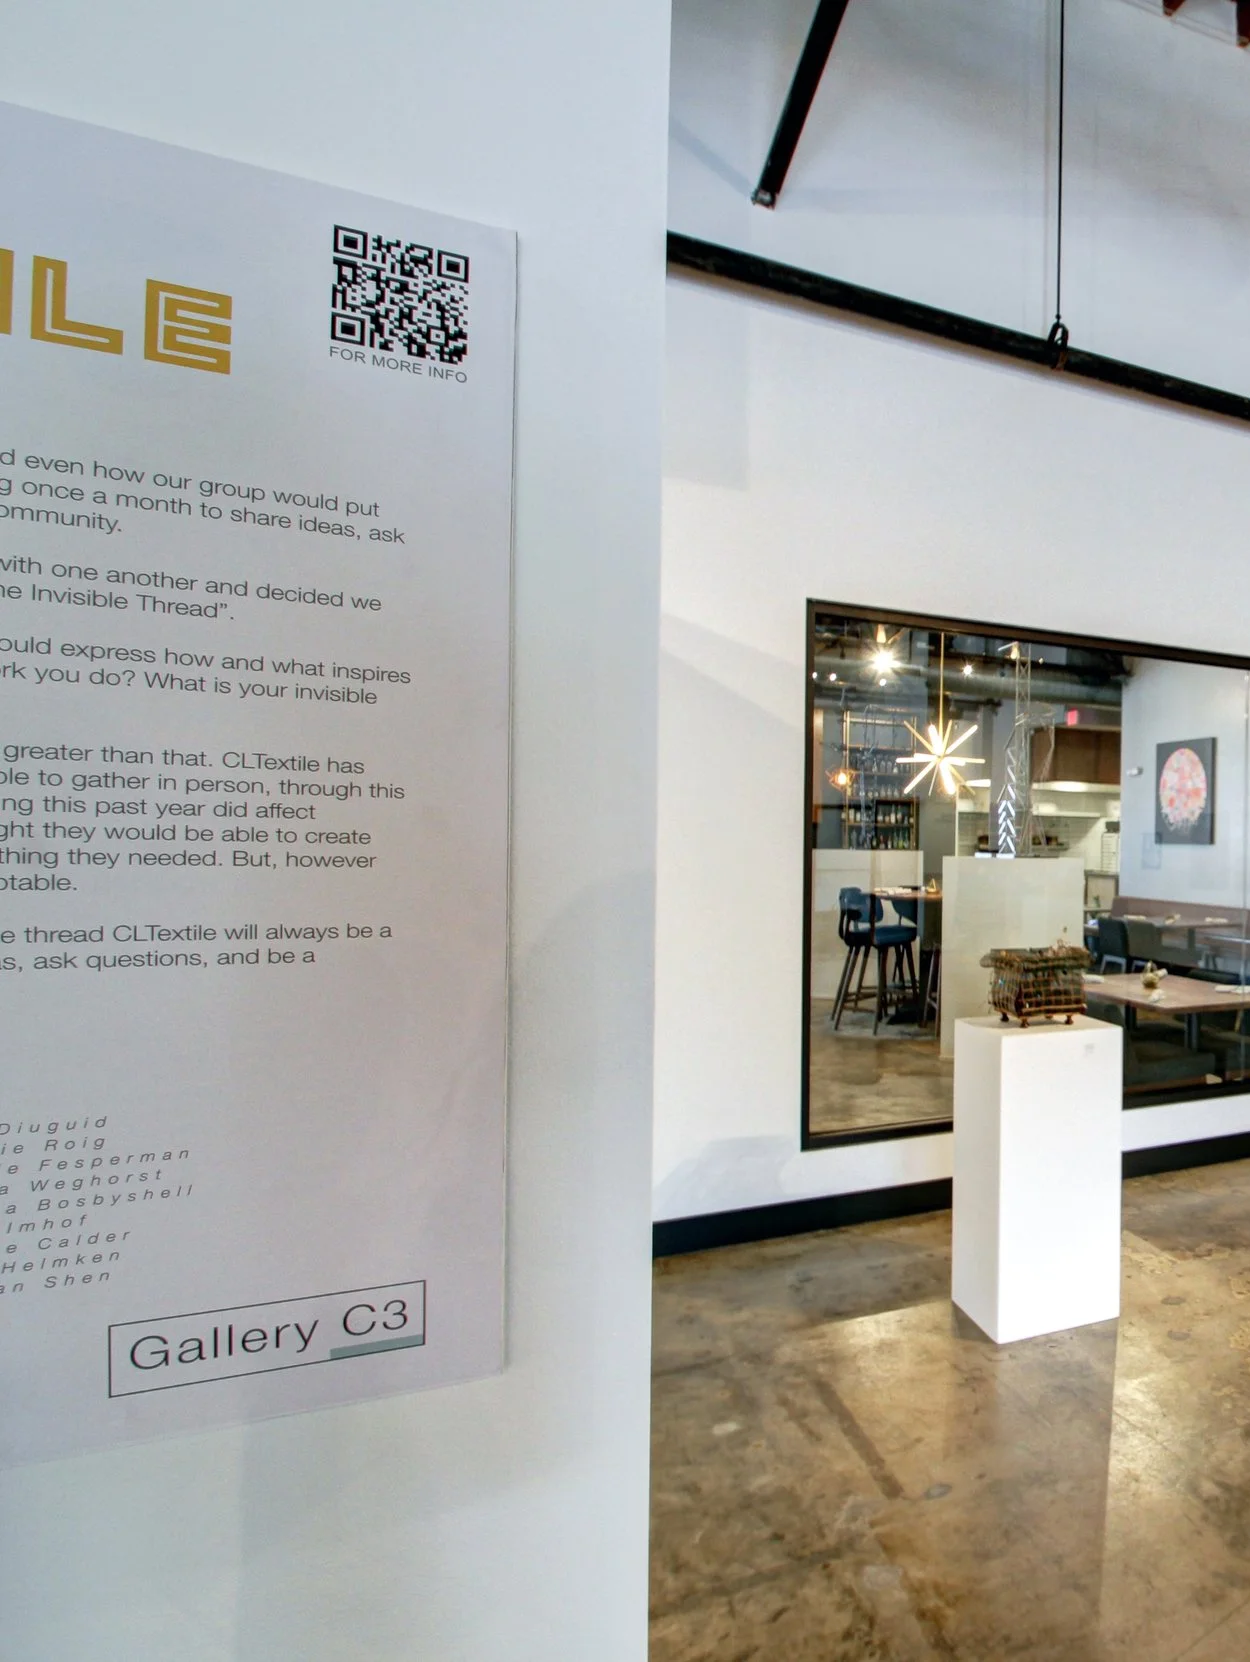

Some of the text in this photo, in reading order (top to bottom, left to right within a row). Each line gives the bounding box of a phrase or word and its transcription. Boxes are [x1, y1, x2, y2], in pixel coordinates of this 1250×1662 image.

[329, 345, 468, 384] FOR MORE INFO
[23, 455, 84, 476] even
[92, 459, 146, 484] how
[152, 473, 193, 491] our
[199, 479, 266, 504] group
[271, 489, 339, 512] would
[345, 501, 380, 518] put
[21, 481, 85, 502] once
[92, 490, 108, 505] a
[115, 493, 192, 516] month
[199, 501, 223, 520] to
[229, 506, 292, 529] share
[298, 516, 361, 541] ideas,
[368, 527, 406, 545] ask
[31, 583, 129, 610] Invisible
[51, 563, 99, 581] one
[105, 569, 199, 592] another
[204, 580, 249, 597] and
[255, 583, 344, 608] decided
[350, 596, 382, 612] we
[59, 643, 157, 664] express
[164, 647, 215, 668] how
[220, 655, 265, 672] and
[271, 658, 326, 678] what
[332, 661, 412, 685] inspires
[0, 661, 378, 705] rk you do? What is your invisible
[3, 743, 365, 775] greater than that. CLTextile has
[37, 769, 64, 787] to
[71, 771, 151, 792] gather
[157, 773, 177, 791] in
[185, 778, 271, 797] person,
[277, 778, 362, 802] through
[368, 782, 406, 800] this
[1, 795, 317, 820] ng this past year did affect
[41, 821, 97, 844] they
[103, 823, 177, 842] would
[184, 824, 214, 842] be
[221, 825, 269, 843] able
[275, 827, 298, 844] to
[304, 829, 372, 845] create
[66, 847, 121, 870] they
[128, 849, 223, 867] needed.
[232, 849, 277, 870] But,
[285, 850, 378, 869] however
[23, 925, 104, 944] thread
[112, 924, 217, 943] CLTextile
[223, 923, 258, 941] will
[265, 923, 340, 944] always
[346, 922, 374, 939] be
[378, 925, 393, 939] a
[0, 947, 316, 973] s, ask questions, and be a
[0, 1115, 108, 1136] Diuguid
[43, 1136, 106, 1152] Roig
[37, 1149, 190, 1172] Fesperman
[29, 1168, 162, 1193] Weghorst
[36, 1183, 193, 1212] Bosbyshell
[5, 1213, 88, 1235] Imhof
[37, 1231, 131, 1251] Calder
[0, 1251, 120, 1275] Helmken
[43, 1271, 110, 1289] Shen
[129, 1299, 409, 1370] Gallery C3
